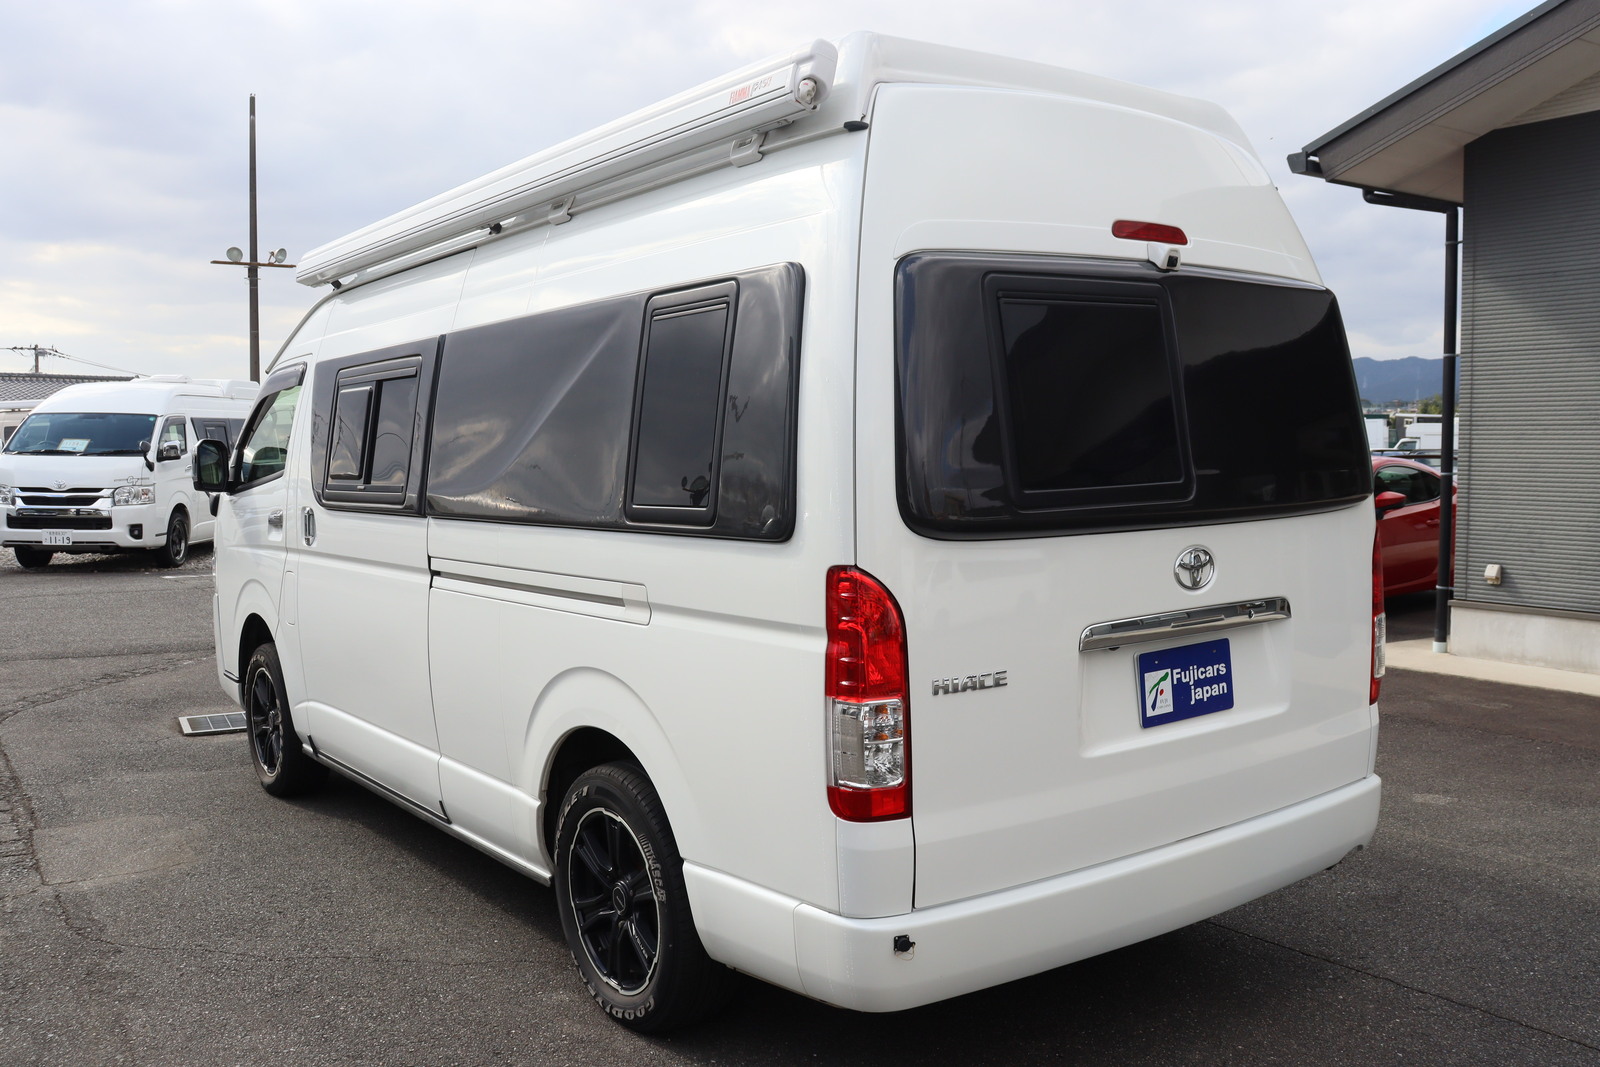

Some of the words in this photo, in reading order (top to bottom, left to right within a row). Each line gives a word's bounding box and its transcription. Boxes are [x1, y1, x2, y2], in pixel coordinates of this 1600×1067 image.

[932, 670, 1008, 696] HIACE
[1173, 663, 1227, 685] Fujicars
[1190, 682, 1227, 705] japan
